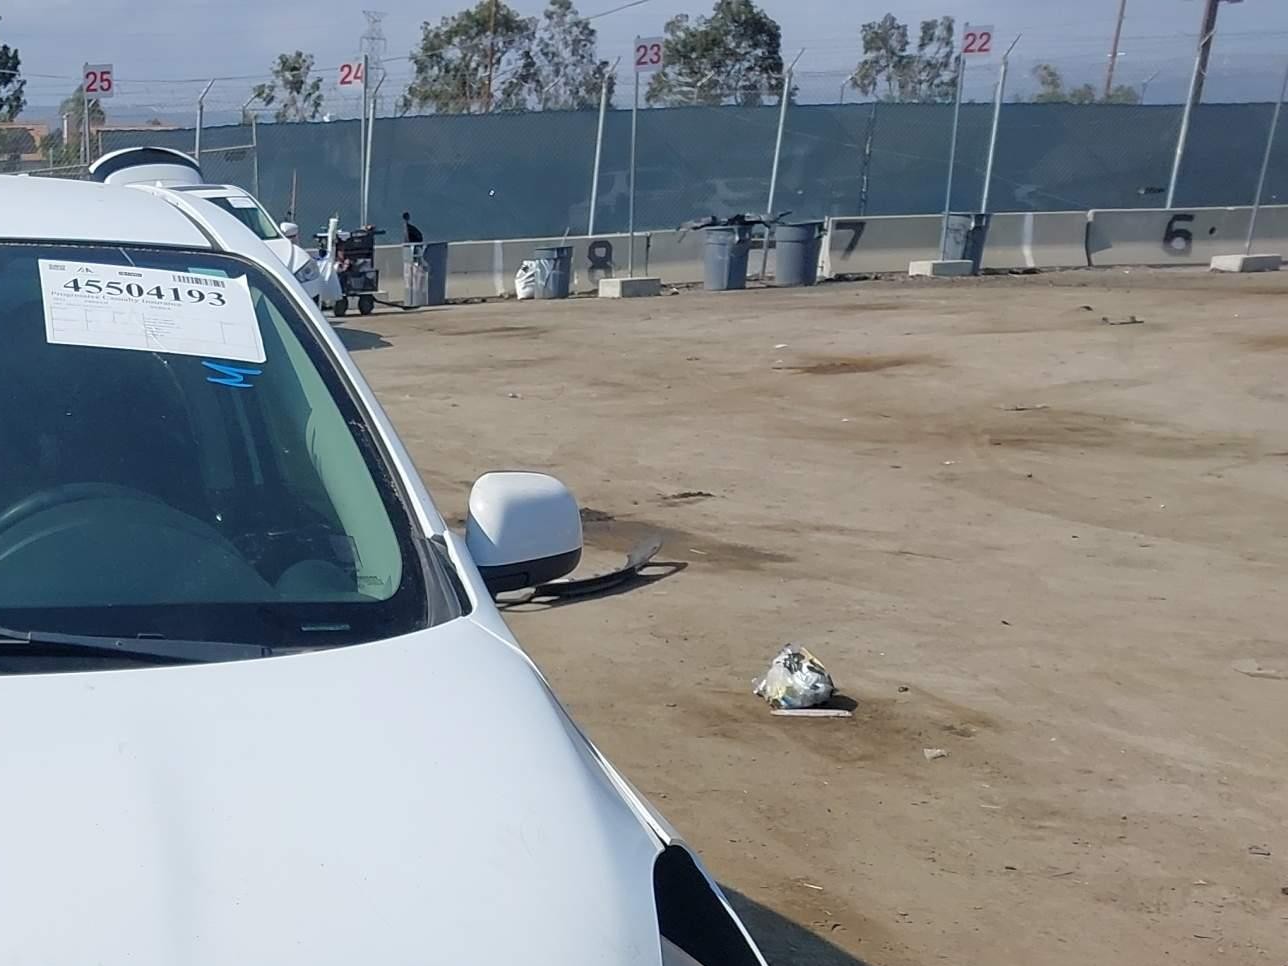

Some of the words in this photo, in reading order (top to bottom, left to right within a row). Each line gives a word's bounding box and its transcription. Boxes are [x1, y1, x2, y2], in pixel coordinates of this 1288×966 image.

[635, 43, 662, 66] 23
[963, 32, 991, 53] 22
[85, 71, 112, 93] 25
[835, 221, 867, 261] 7
[1162, 213, 1195, 257] 6
[63, 277, 226, 307] 45504193
